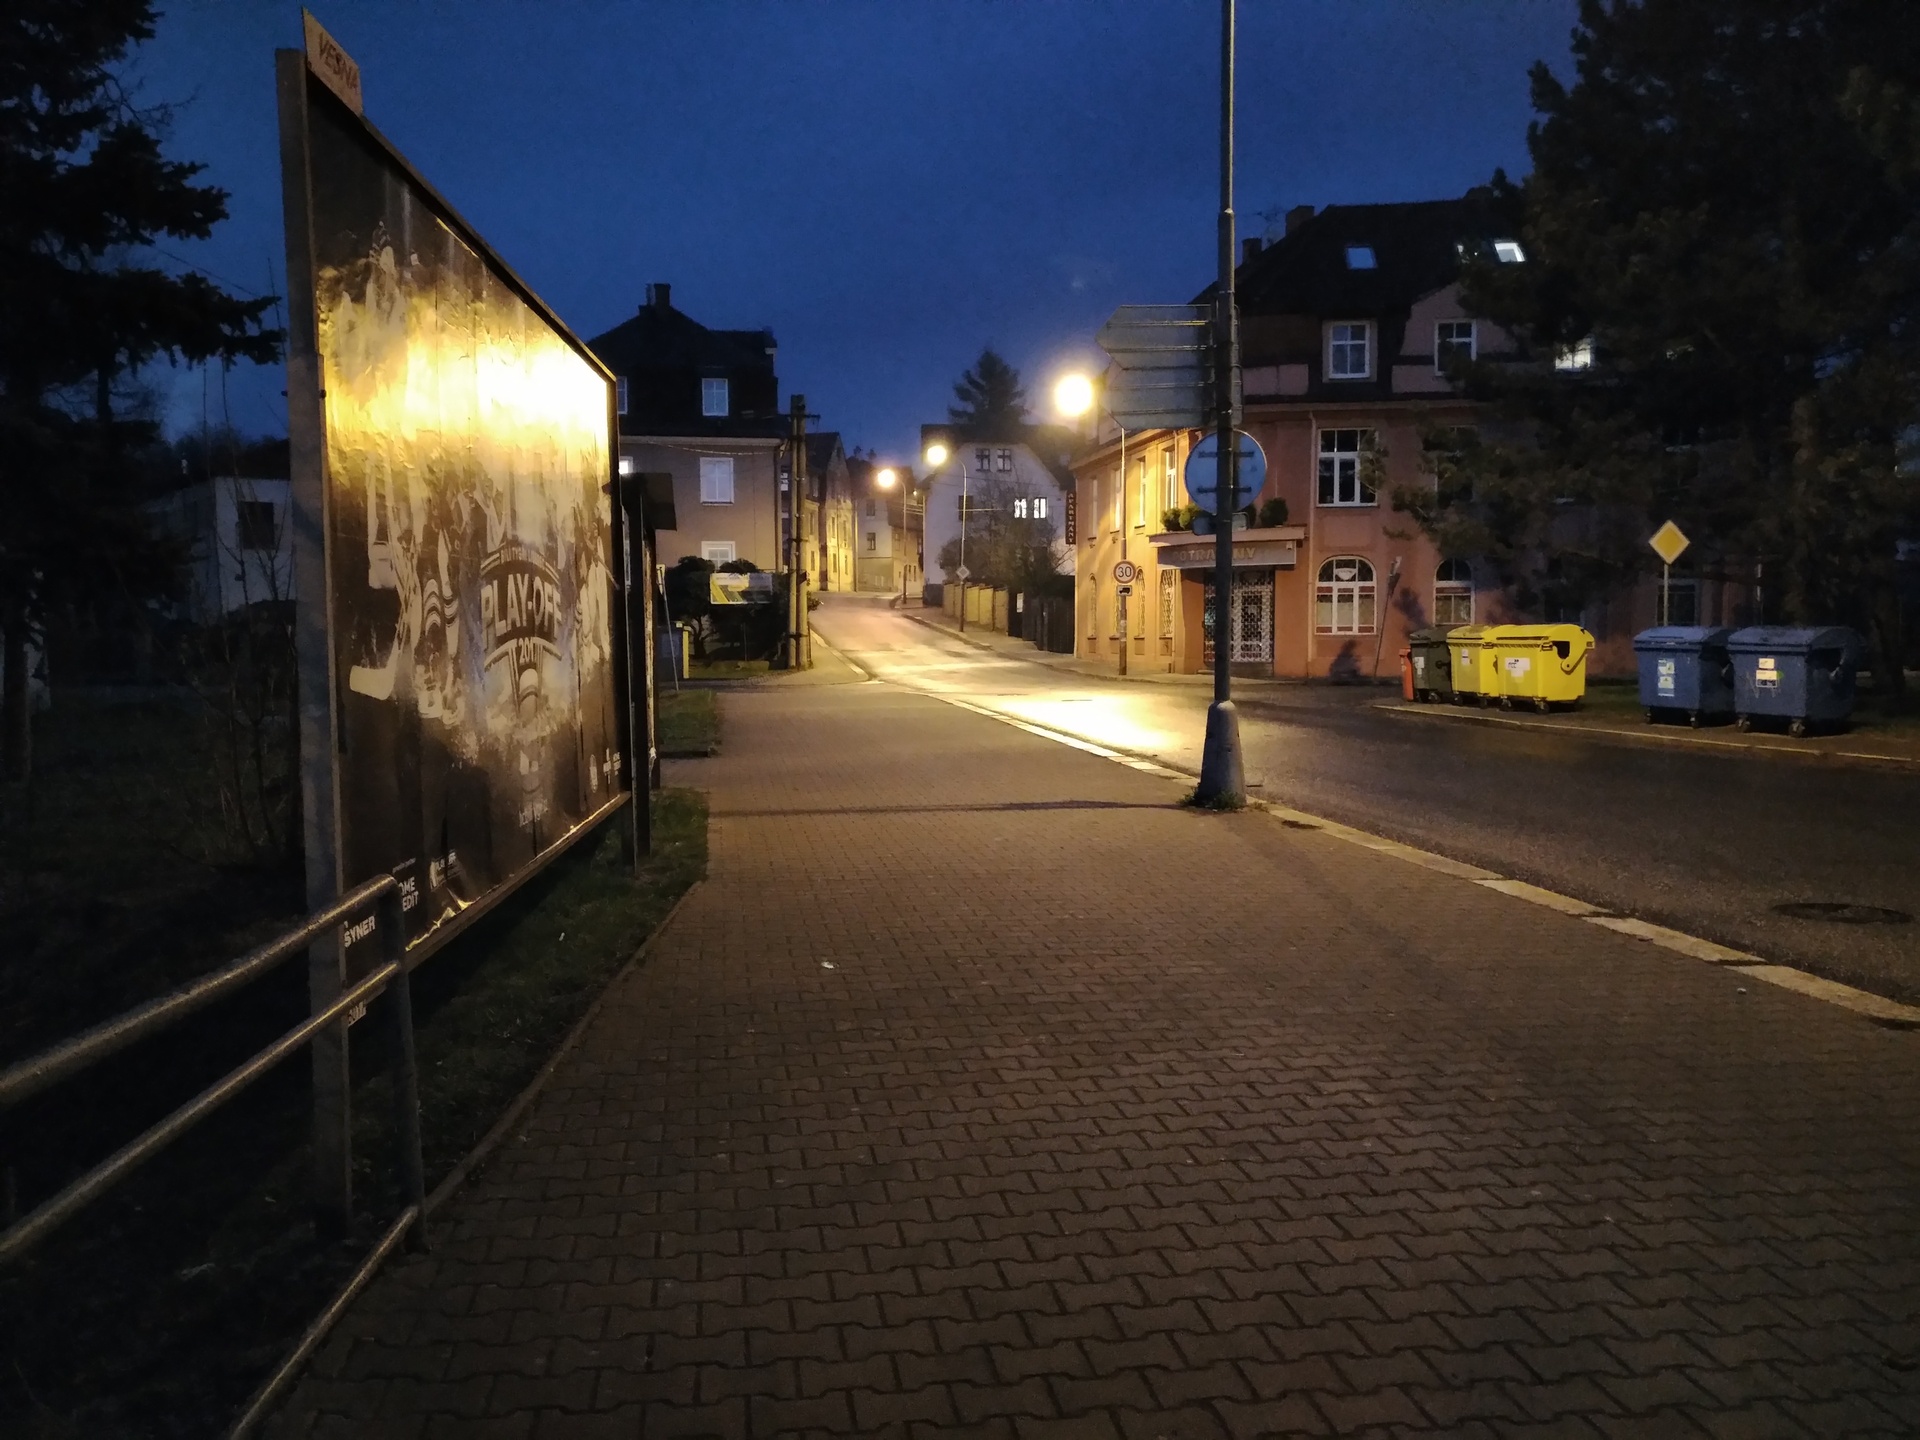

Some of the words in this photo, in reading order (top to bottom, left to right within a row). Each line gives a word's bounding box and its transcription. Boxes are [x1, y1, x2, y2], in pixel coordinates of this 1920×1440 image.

[1172, 547, 1256, 562] POTRANY
[1117, 566, 1132, 578] 30
[481, 573, 562, 645] PLAY-OFF
[402, 891, 419, 912] EDIT
